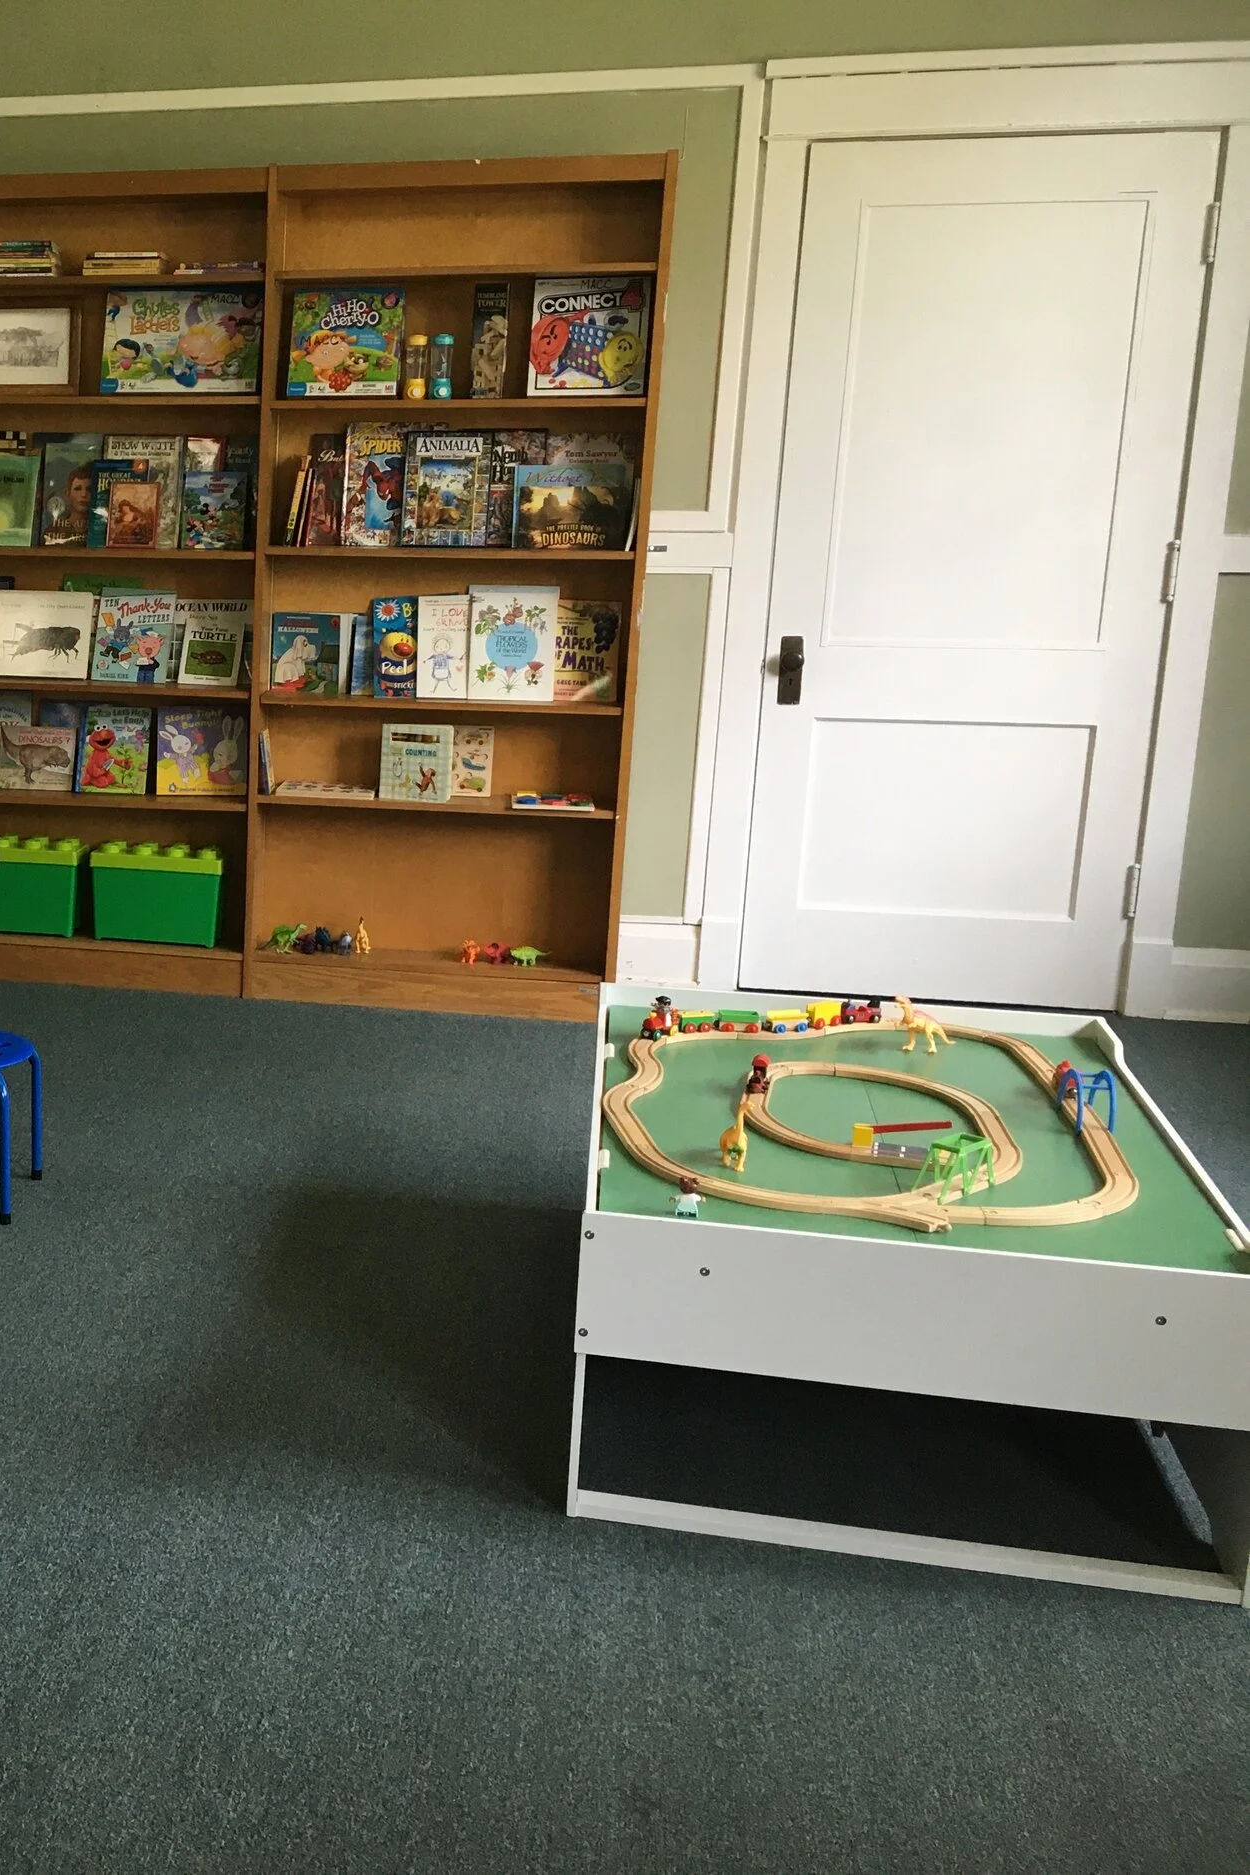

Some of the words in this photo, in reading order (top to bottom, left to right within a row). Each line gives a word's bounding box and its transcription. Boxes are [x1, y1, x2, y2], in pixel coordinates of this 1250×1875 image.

[477, 299, 507, 308] TOWER
[541, 292, 622, 313] CONNECT
[361, 437, 402, 455] SPIDER
[419, 438, 480, 452] ANIMALIA
[586, 450, 618, 458] Sawyer
[541, 532, 606, 546] DINOSAURS
[104, 598, 120, 608] TEN
[117, 597, 171, 618] Thank-You
[175, 602, 209, 612] OCEAN
[211, 602, 248, 612] WORLD
[441, 607, 469, 617] LOVE
[137, 613, 170, 624] LETTERS
[561, 625, 579, 635] THE
[191, 630, 238, 642] TURTLE
[555, 636, 593, 651] RAPES
[381, 659, 407, 675] Peel
[562, 651, 605, 673] MATH
[124, 716, 144, 725] Earth
[164, 713, 192, 724] Sleep
[405, 748, 437, 757] COUNTING
